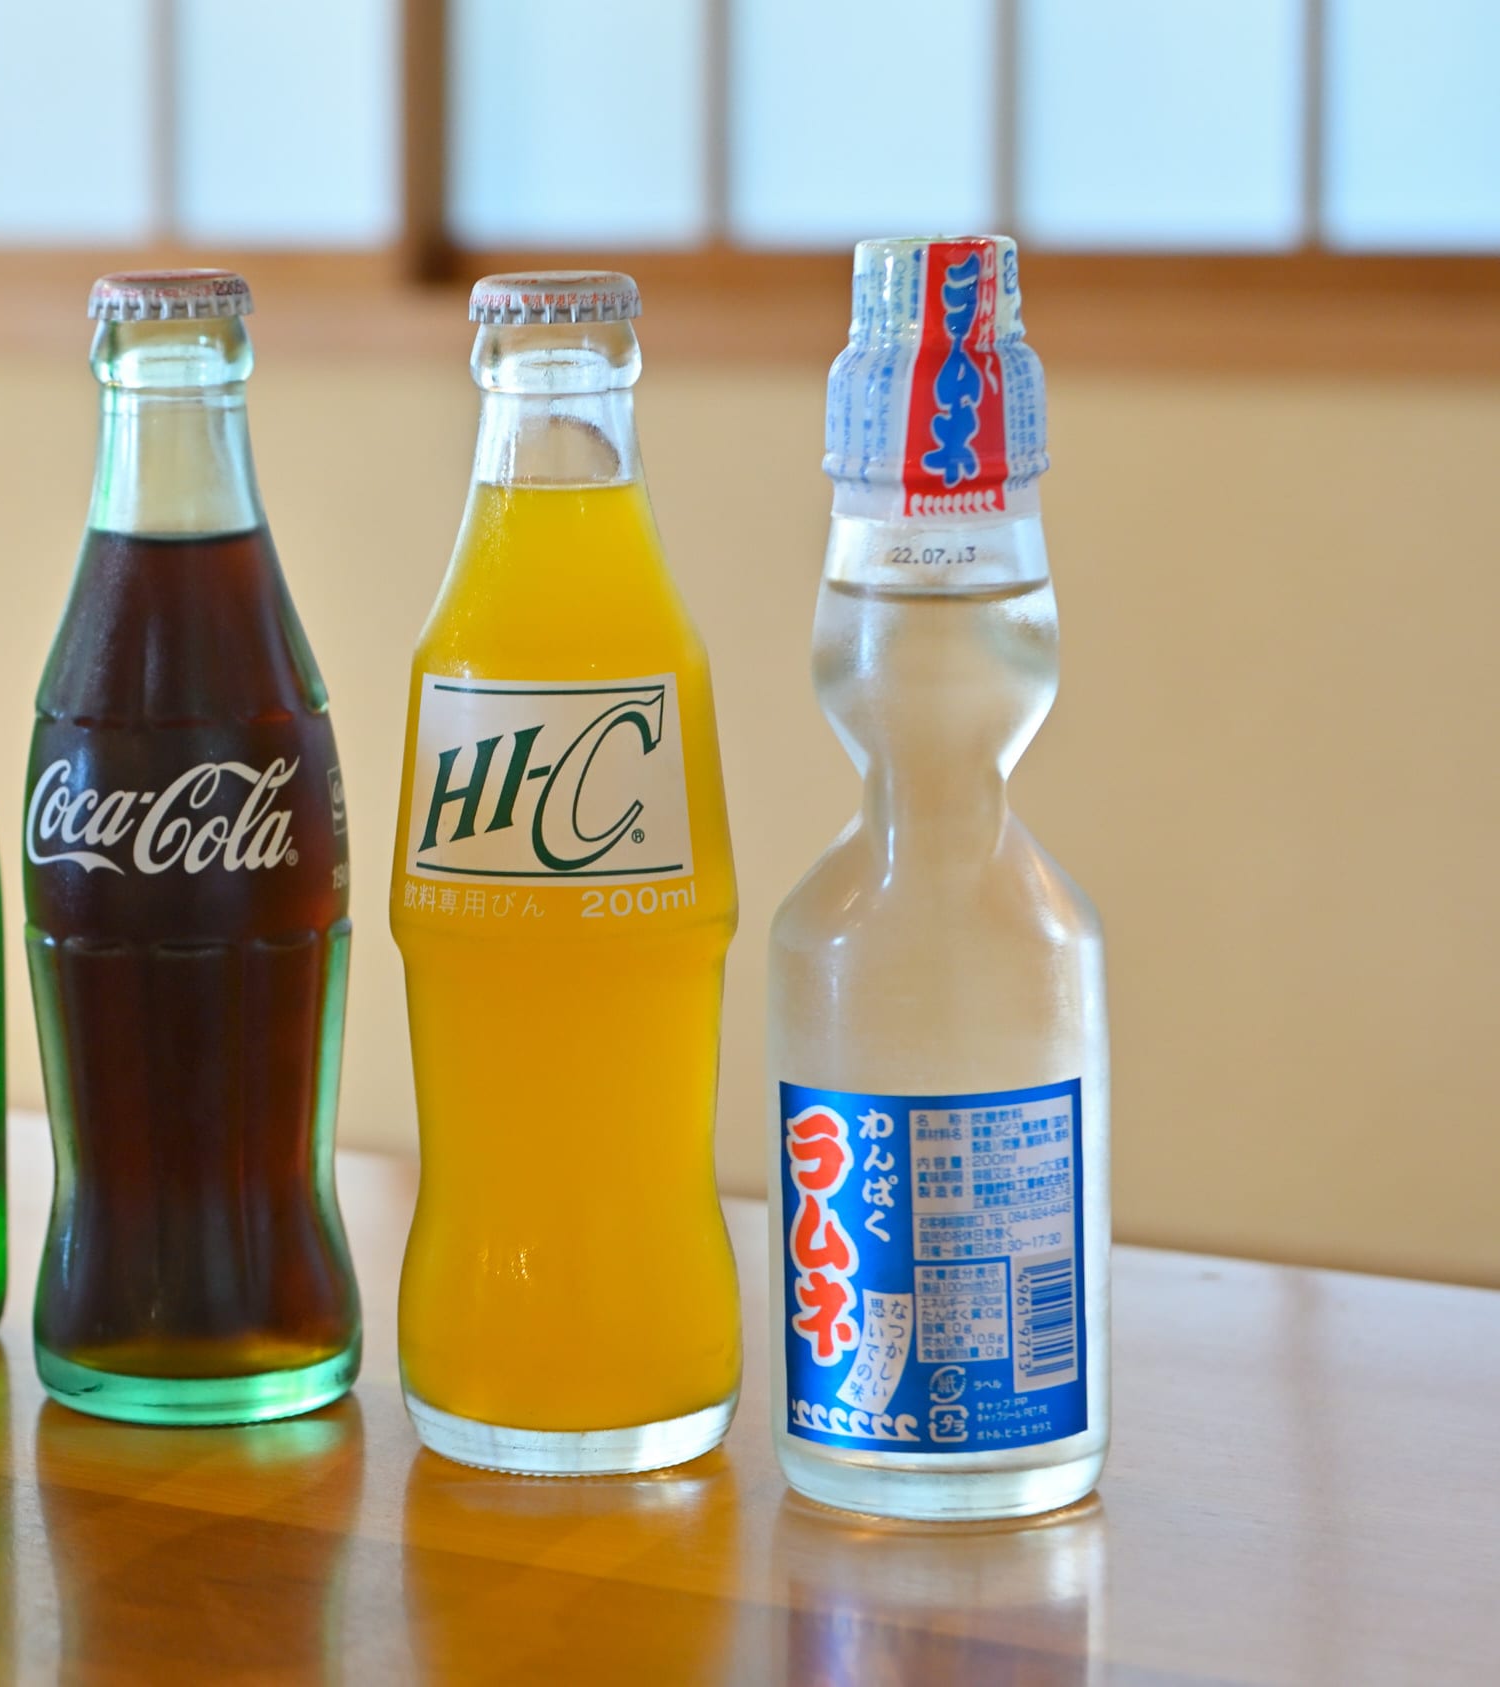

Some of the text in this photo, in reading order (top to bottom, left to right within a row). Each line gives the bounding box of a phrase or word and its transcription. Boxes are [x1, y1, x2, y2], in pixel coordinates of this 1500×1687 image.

[891, 547, 976, 564] 22.07.13
[26, 755, 299, 876] Coca-Cola
[418, 690, 665, 871] HI-C
[403, 880, 697, 919] 飲料専用びん 200ml
[857, 1108, 899, 1243] わんぱく
[787, 1106, 858, 1365] ラムネ
[872, 1299, 908, 1398] なつかしい
[939, 1414, 967, 1434] プラ
